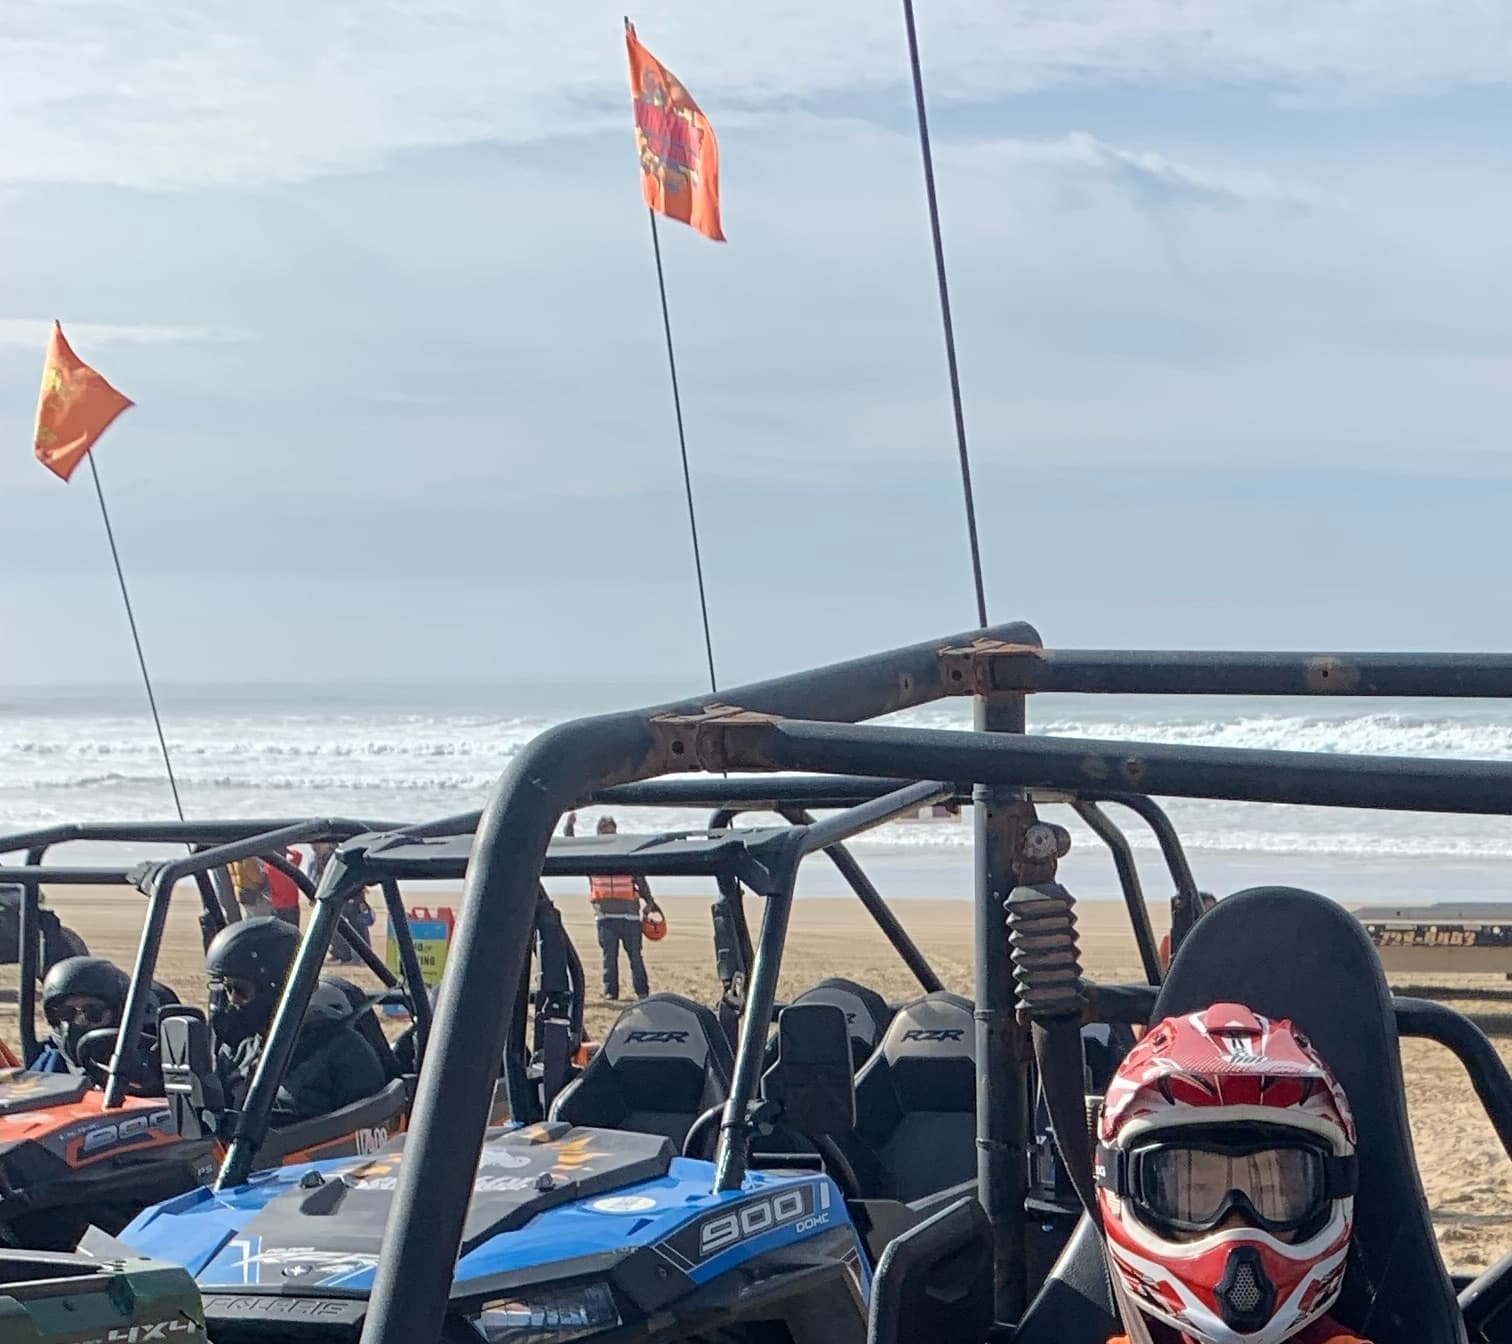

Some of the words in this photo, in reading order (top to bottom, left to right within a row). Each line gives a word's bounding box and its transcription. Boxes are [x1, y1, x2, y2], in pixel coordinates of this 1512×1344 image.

[624, 1031, 689, 1044] RZR
[702, 1191, 803, 1252] 900
[796, 1212, 830, 1233] DOHC
